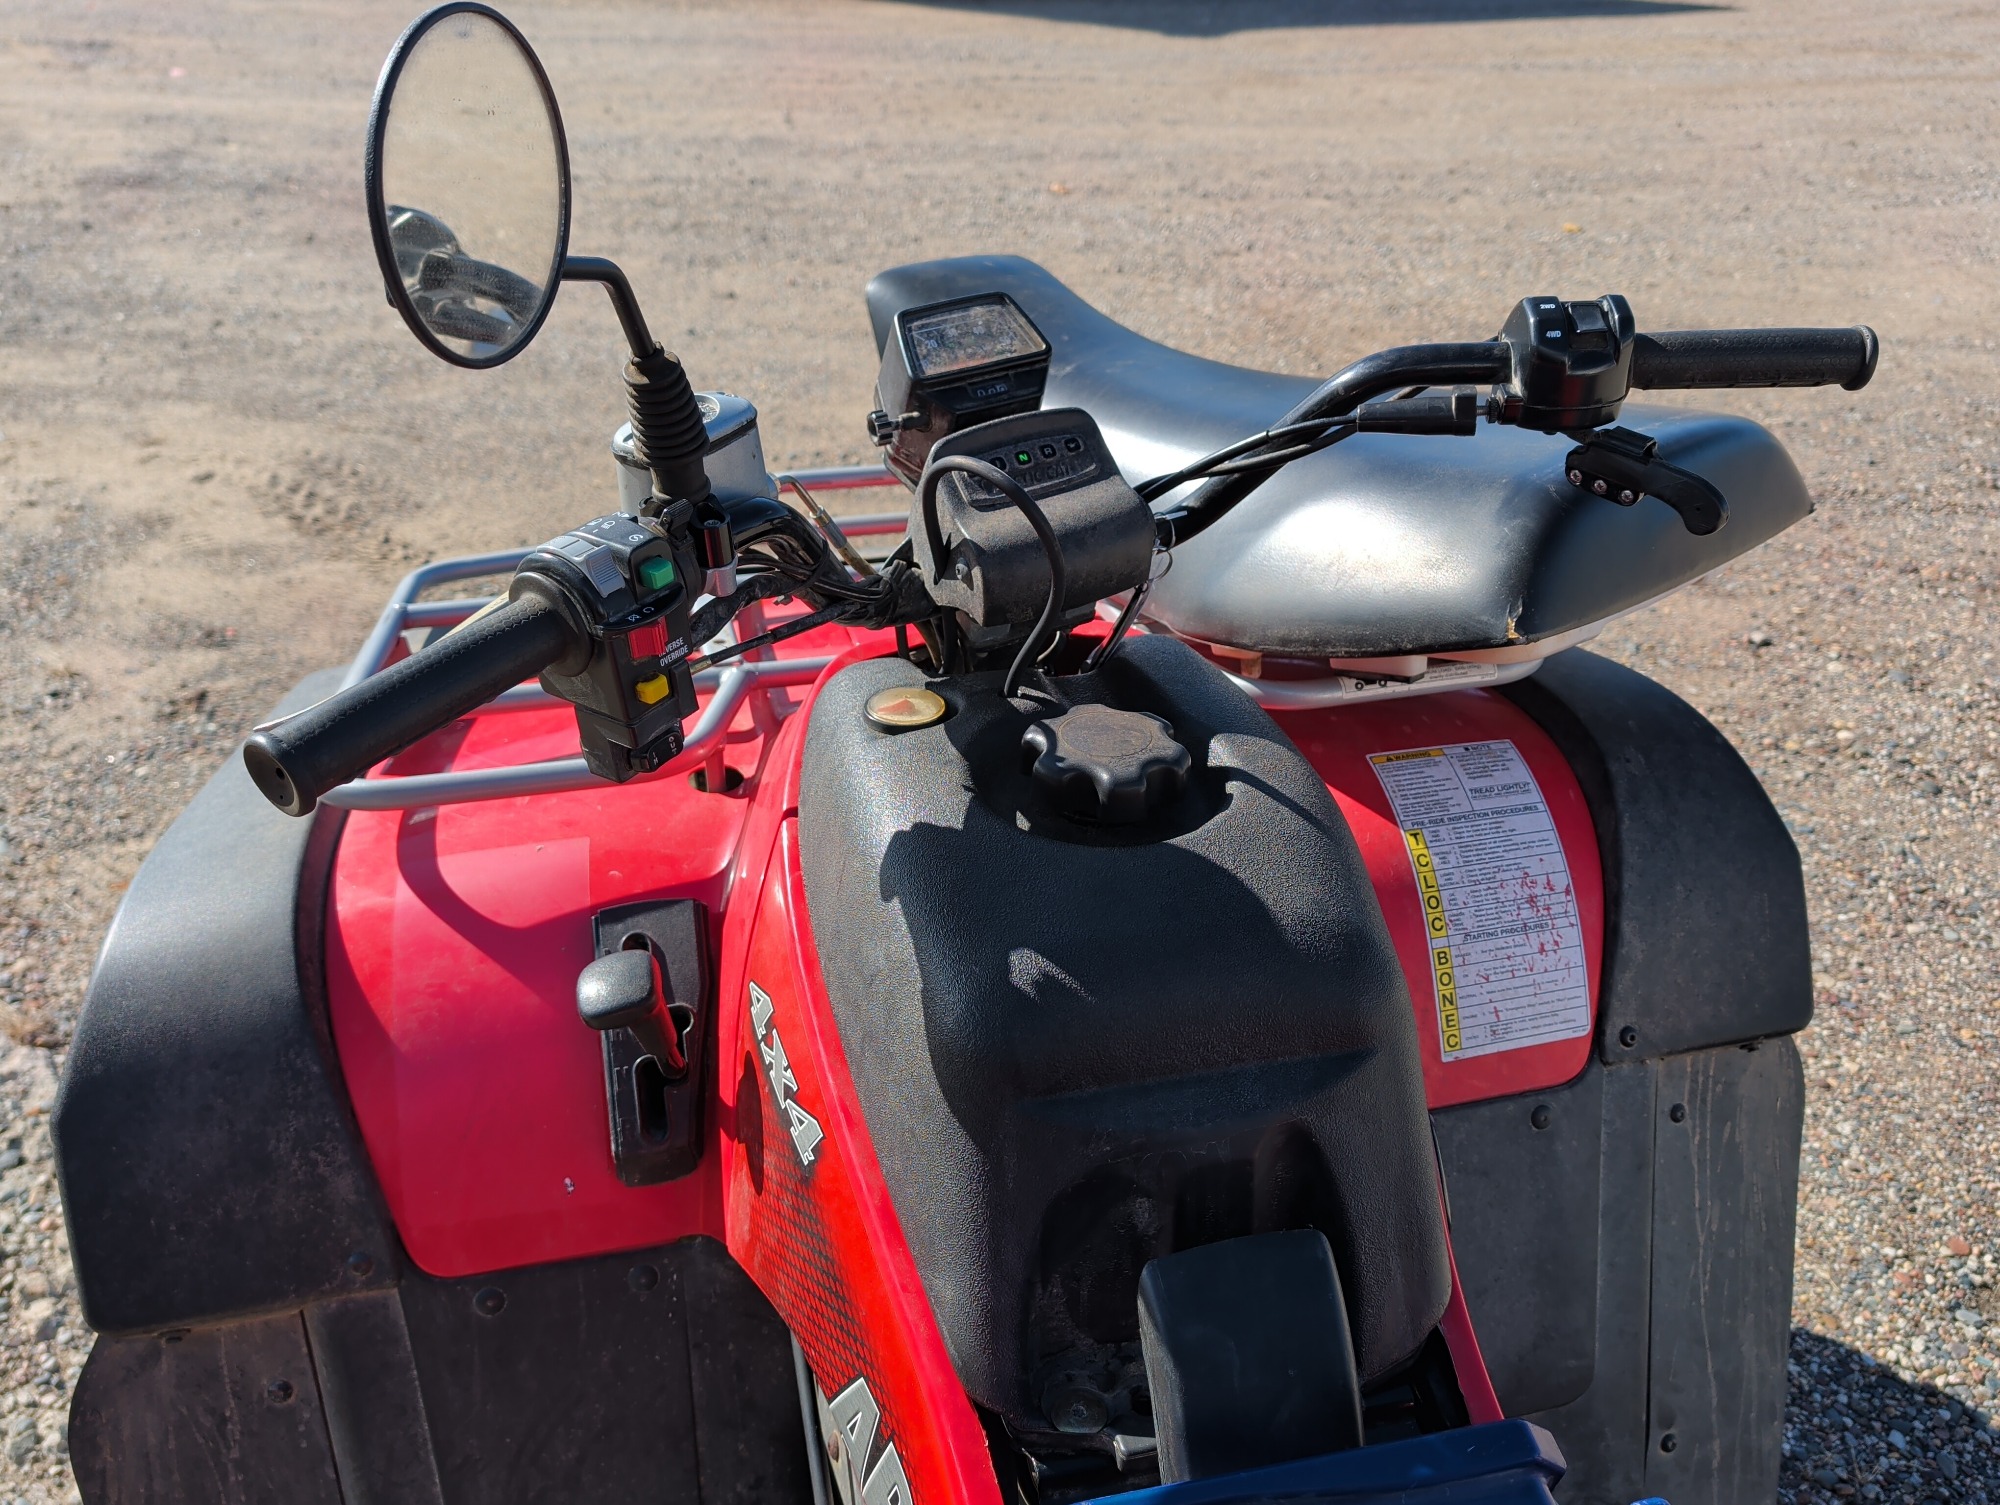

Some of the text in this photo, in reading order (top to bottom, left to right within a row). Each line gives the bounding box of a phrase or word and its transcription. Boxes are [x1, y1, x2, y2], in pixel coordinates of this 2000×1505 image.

[1545, 330, 1562, 338] 4WD
[925, 339, 939, 350] 20
[1018, 453, 1029, 462] N
[1043, 447, 1053, 455] R
[658, 636, 684, 658] VERSE
[659, 644, 689, 667] OVERRIDE
[1393, 751, 1432, 761] WARNING
[1469, 786, 1496, 795] TREAD
[1411, 804, 1539, 828] PRE-RIDE INSPECTION PROCEDURES
[1409, 832, 1420, 845] T
[1416, 854, 1429, 868] C
[1424, 876, 1435, 889] L
[1426, 895, 1440, 909] O
[1431, 917, 1444, 932] C
[1463, 922, 1550, 942] STARTING PROCEDURES
[1437, 951, 1449, 965] B
[1439, 972, 1452, 986] O
[1441, 993, 1455, 1007] N
[1445, 1014, 1456, 1028] E
[1447, 1034, 1459, 1048] C
